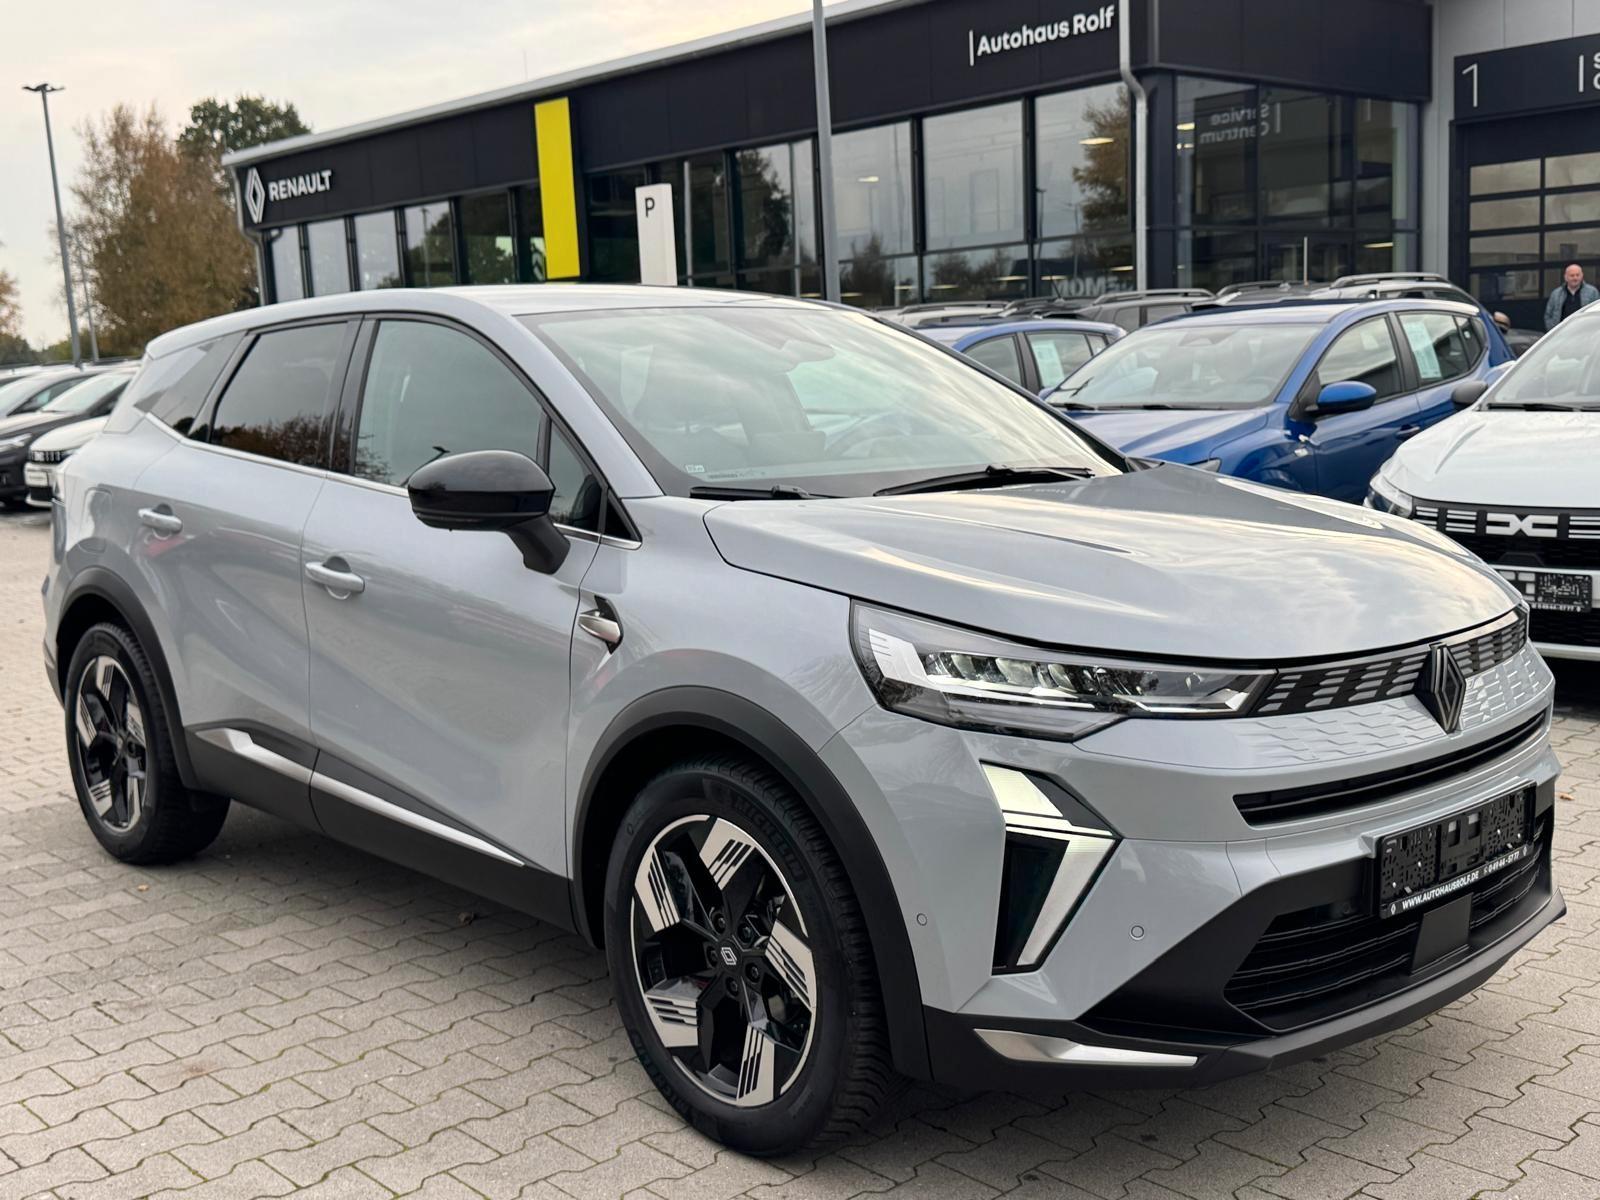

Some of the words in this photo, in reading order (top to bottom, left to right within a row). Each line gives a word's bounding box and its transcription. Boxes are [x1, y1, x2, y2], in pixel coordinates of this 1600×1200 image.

[977, 20, 1070, 56] Autohaus
[1073, 5, 1115, 35] Rolf
[1462, 63, 1478, 107] 1
[268, 170, 332, 201] RENAULT
[644, 197, 655, 218] P
[733, 794, 807, 882] MICHELIN
[1402, 870, 1480, 910] WWW.AUTOHAUSROLF.DE
